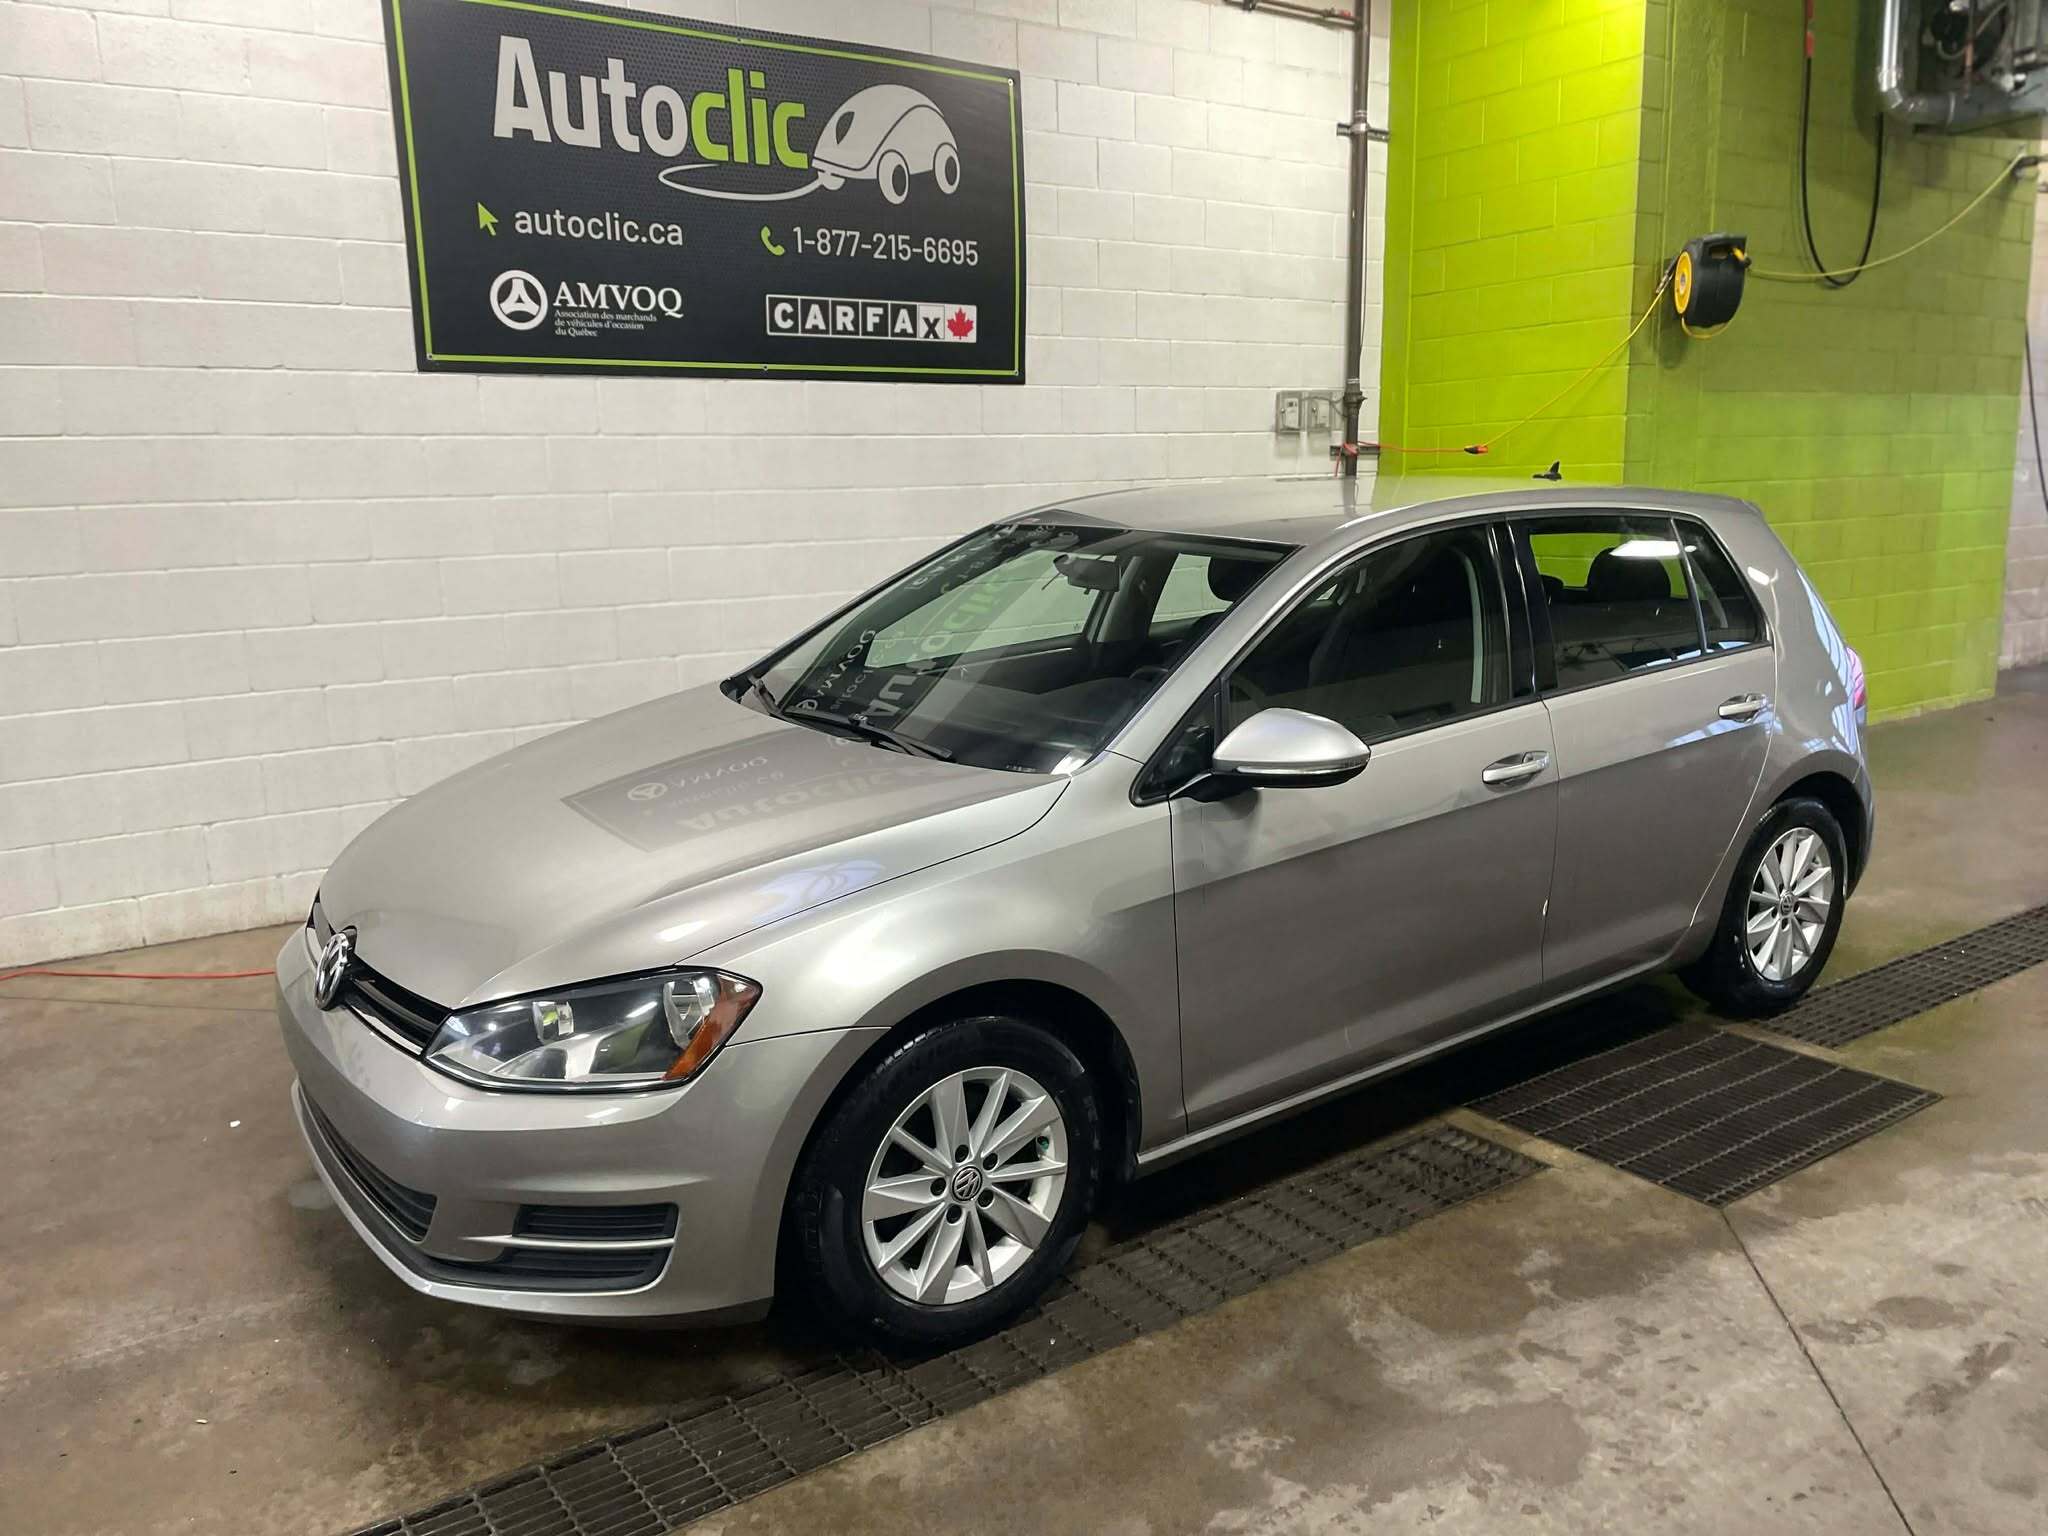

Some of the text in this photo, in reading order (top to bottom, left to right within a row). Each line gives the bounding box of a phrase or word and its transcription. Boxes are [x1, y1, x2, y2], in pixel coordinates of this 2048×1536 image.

[493, 35, 809, 170] Autoclic
[514, 209, 684, 246] autoclic.ca
[793, 226, 979, 266] 1-877-215-6695
[552, 281, 684, 319] AMVOQ
[554, 310, 657, 322] Association des marchands
[555, 319, 645, 330] de véhicules d'occasion
[568, 328, 598, 337] Québec
[773, 302, 941, 340] CARFAX
